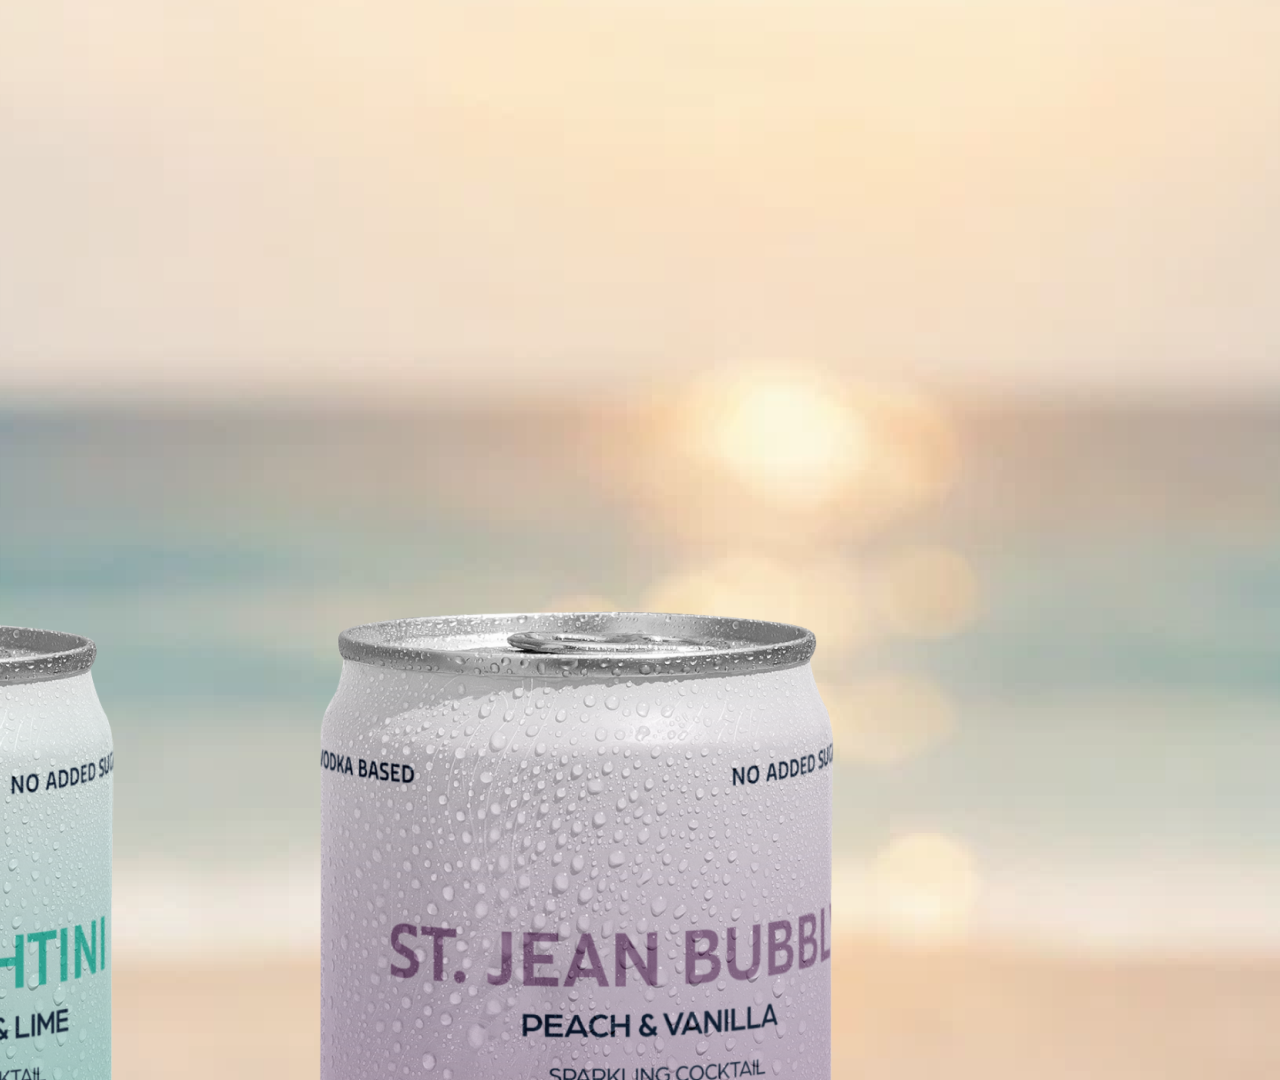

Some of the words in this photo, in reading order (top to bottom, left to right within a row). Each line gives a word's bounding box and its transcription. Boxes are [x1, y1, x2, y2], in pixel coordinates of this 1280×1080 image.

[11, 773, 39, 794] NO
[46, 762, 96, 791] ADDED
[359, 759, 415, 783] BASED
[732, 765, 760, 786] NO
[766, 754, 816, 782] ADDED
[390, 923, 466, 985] ST.
[486, 930, 658, 988] JEAN
[685, 903, 832, 985] BUBBL
[15, 1008, 69, 1039] LIME
[522, 1013, 630, 1038] PEACH
[638, 1013, 658, 1037] &
[662, 1004, 778, 1037] VANILLA
